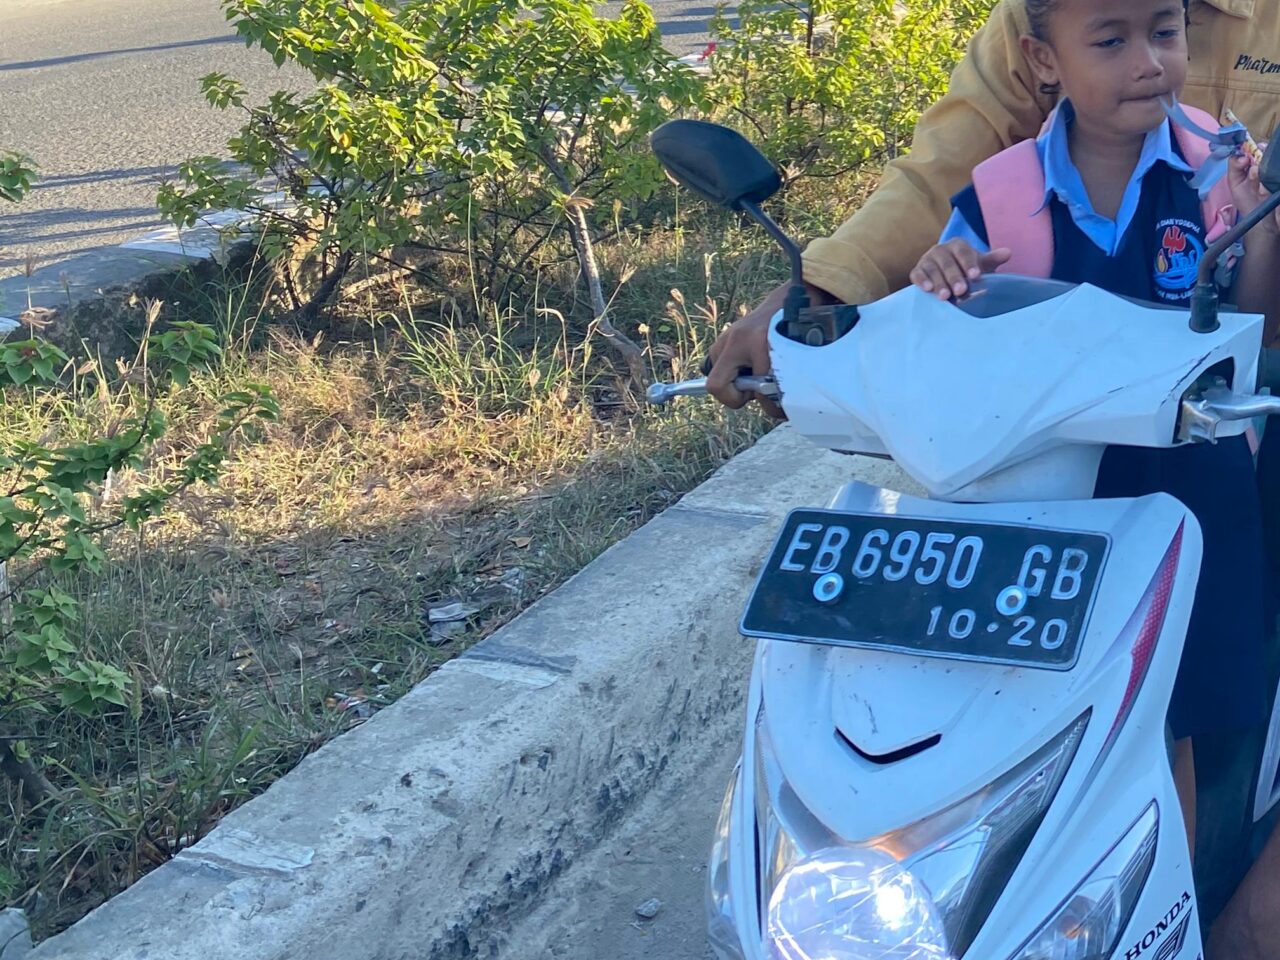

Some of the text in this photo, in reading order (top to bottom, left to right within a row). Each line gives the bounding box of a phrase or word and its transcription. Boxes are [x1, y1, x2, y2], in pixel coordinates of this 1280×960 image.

[780, 523, 1089, 601] EB 6950 GB
[1122, 890, 1191, 960] HONDA
